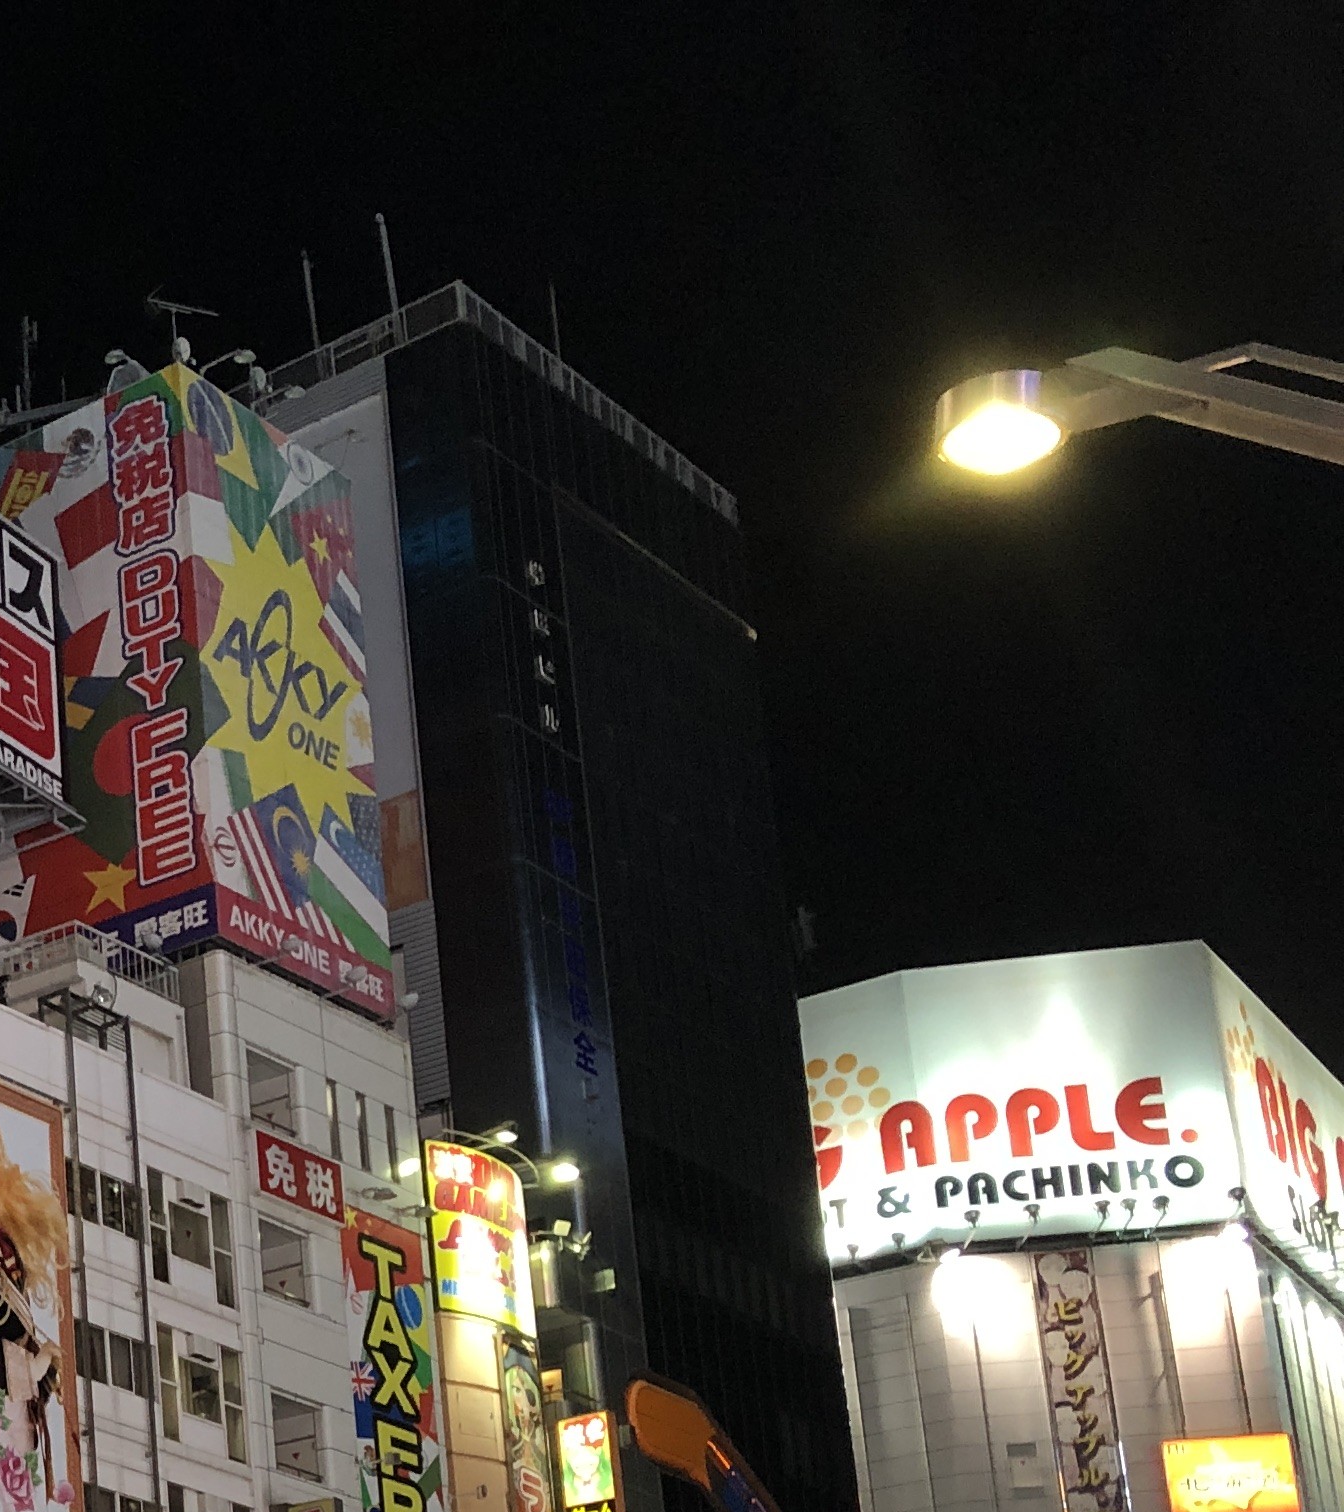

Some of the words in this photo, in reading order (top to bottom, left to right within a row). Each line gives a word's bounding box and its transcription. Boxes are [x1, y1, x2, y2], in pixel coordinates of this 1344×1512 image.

[111, 396, 171, 553] 免税店
[121, 549, 183, 710] DUTY
[212, 600, 348, 735] AKKY
[130, 709, 194, 886] FREE
[287, 720, 341, 771] ONE
[230, 905, 283, 950] AKKY
[265, 1141, 338, 1215] 免税
[876, 1186, 912, 1219] &
[934, 1155, 1205, 1208] PACHINKO
[1255, 1056, 1328, 1202] BIG
[360, 1235, 418, 1419] TAX
